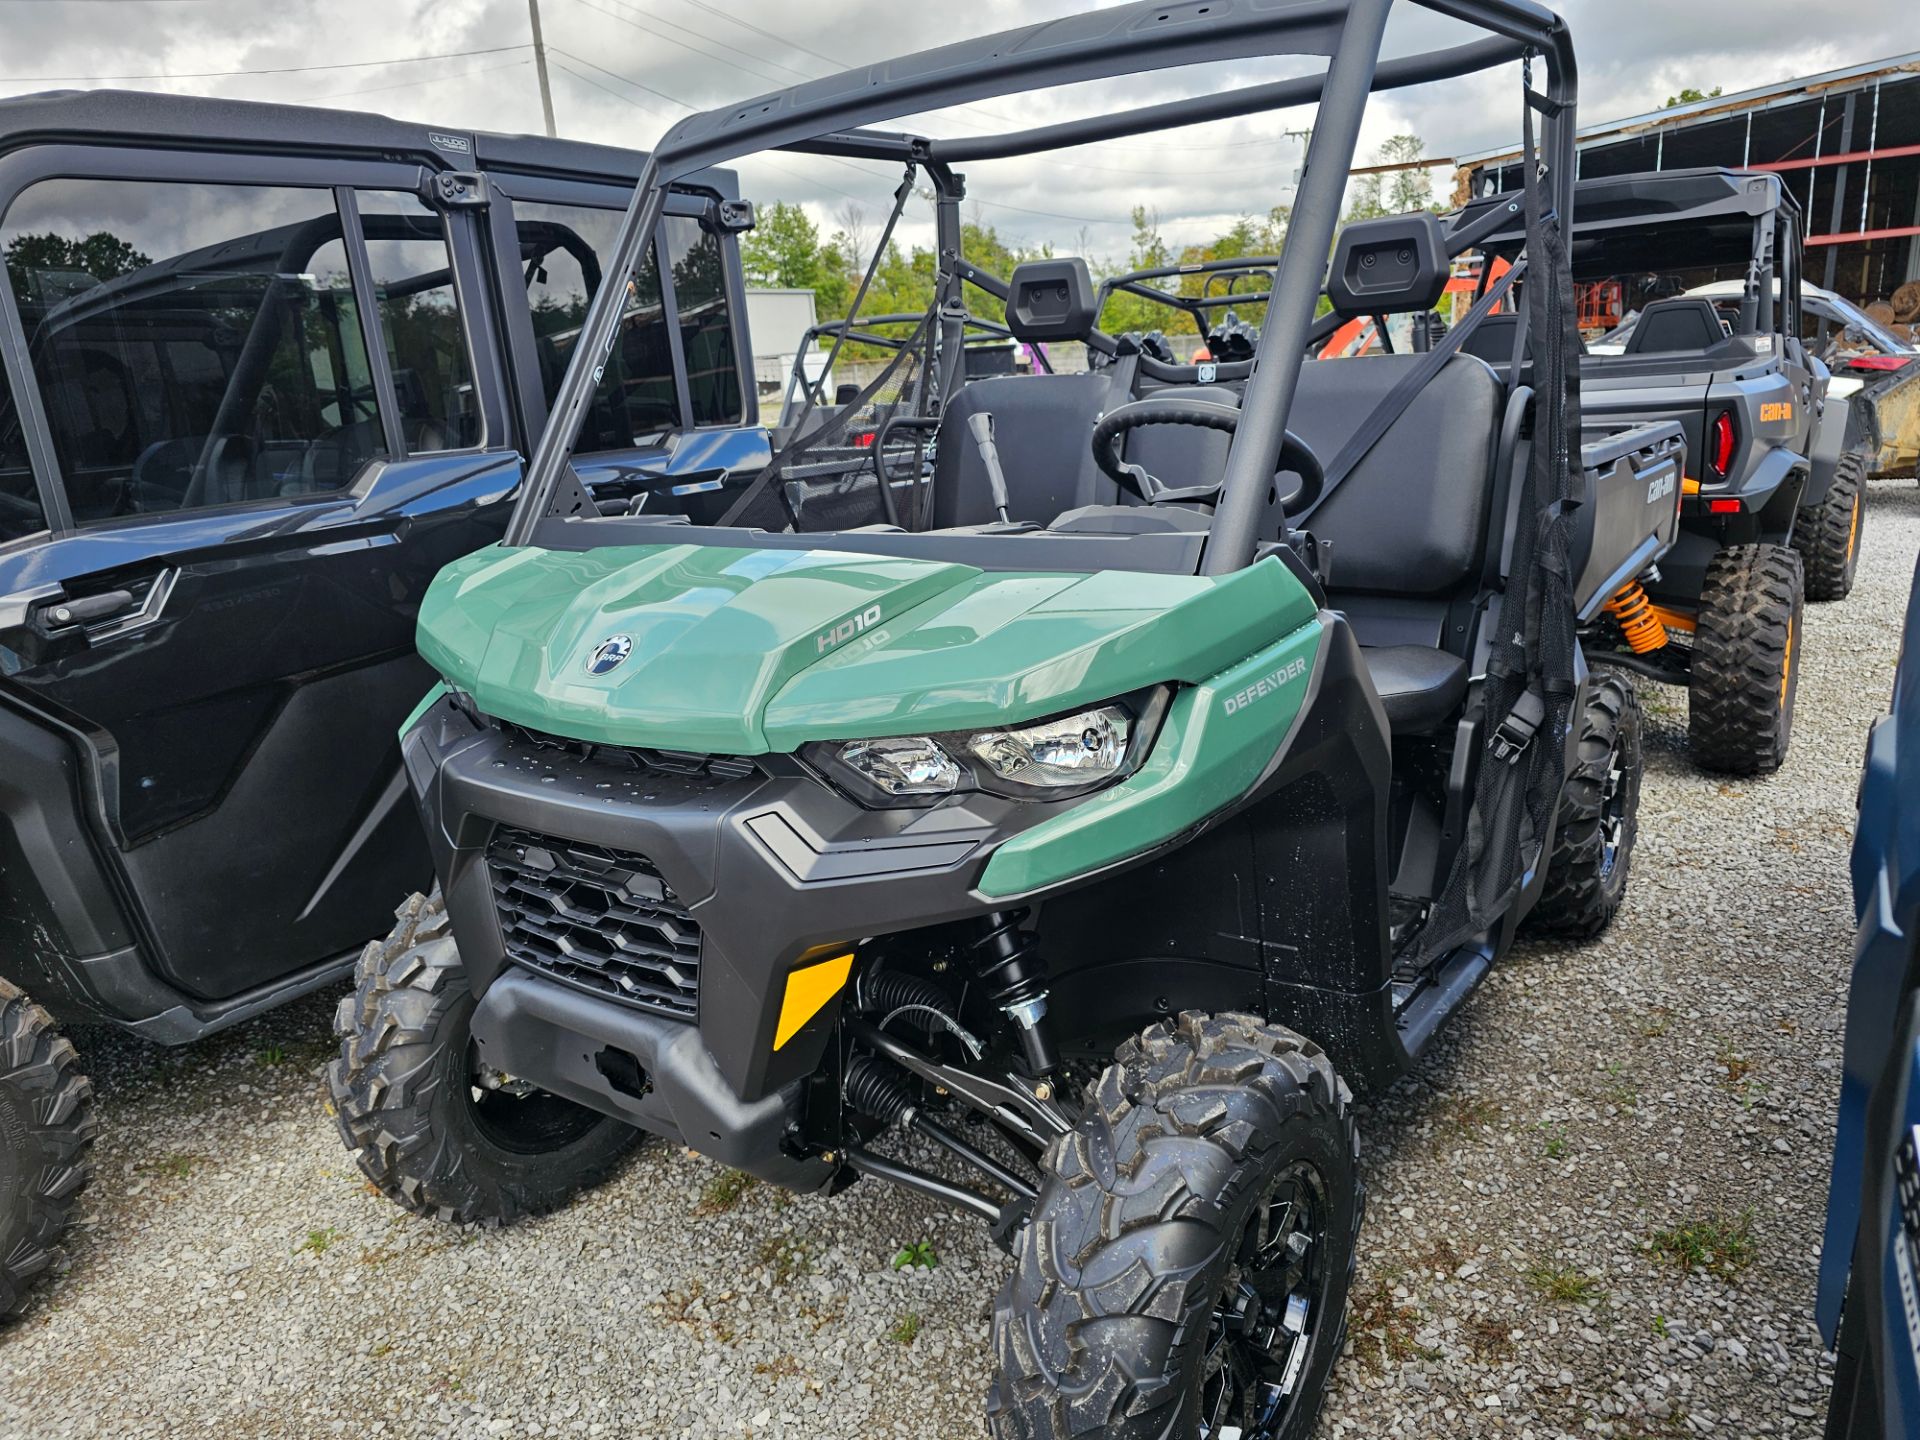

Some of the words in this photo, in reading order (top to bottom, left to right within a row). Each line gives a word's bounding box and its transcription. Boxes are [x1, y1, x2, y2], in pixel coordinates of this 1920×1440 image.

[817, 604, 881, 654] HD10
[600, 653, 624, 662] BRP
[1224, 658, 1306, 715] DEFENDER
